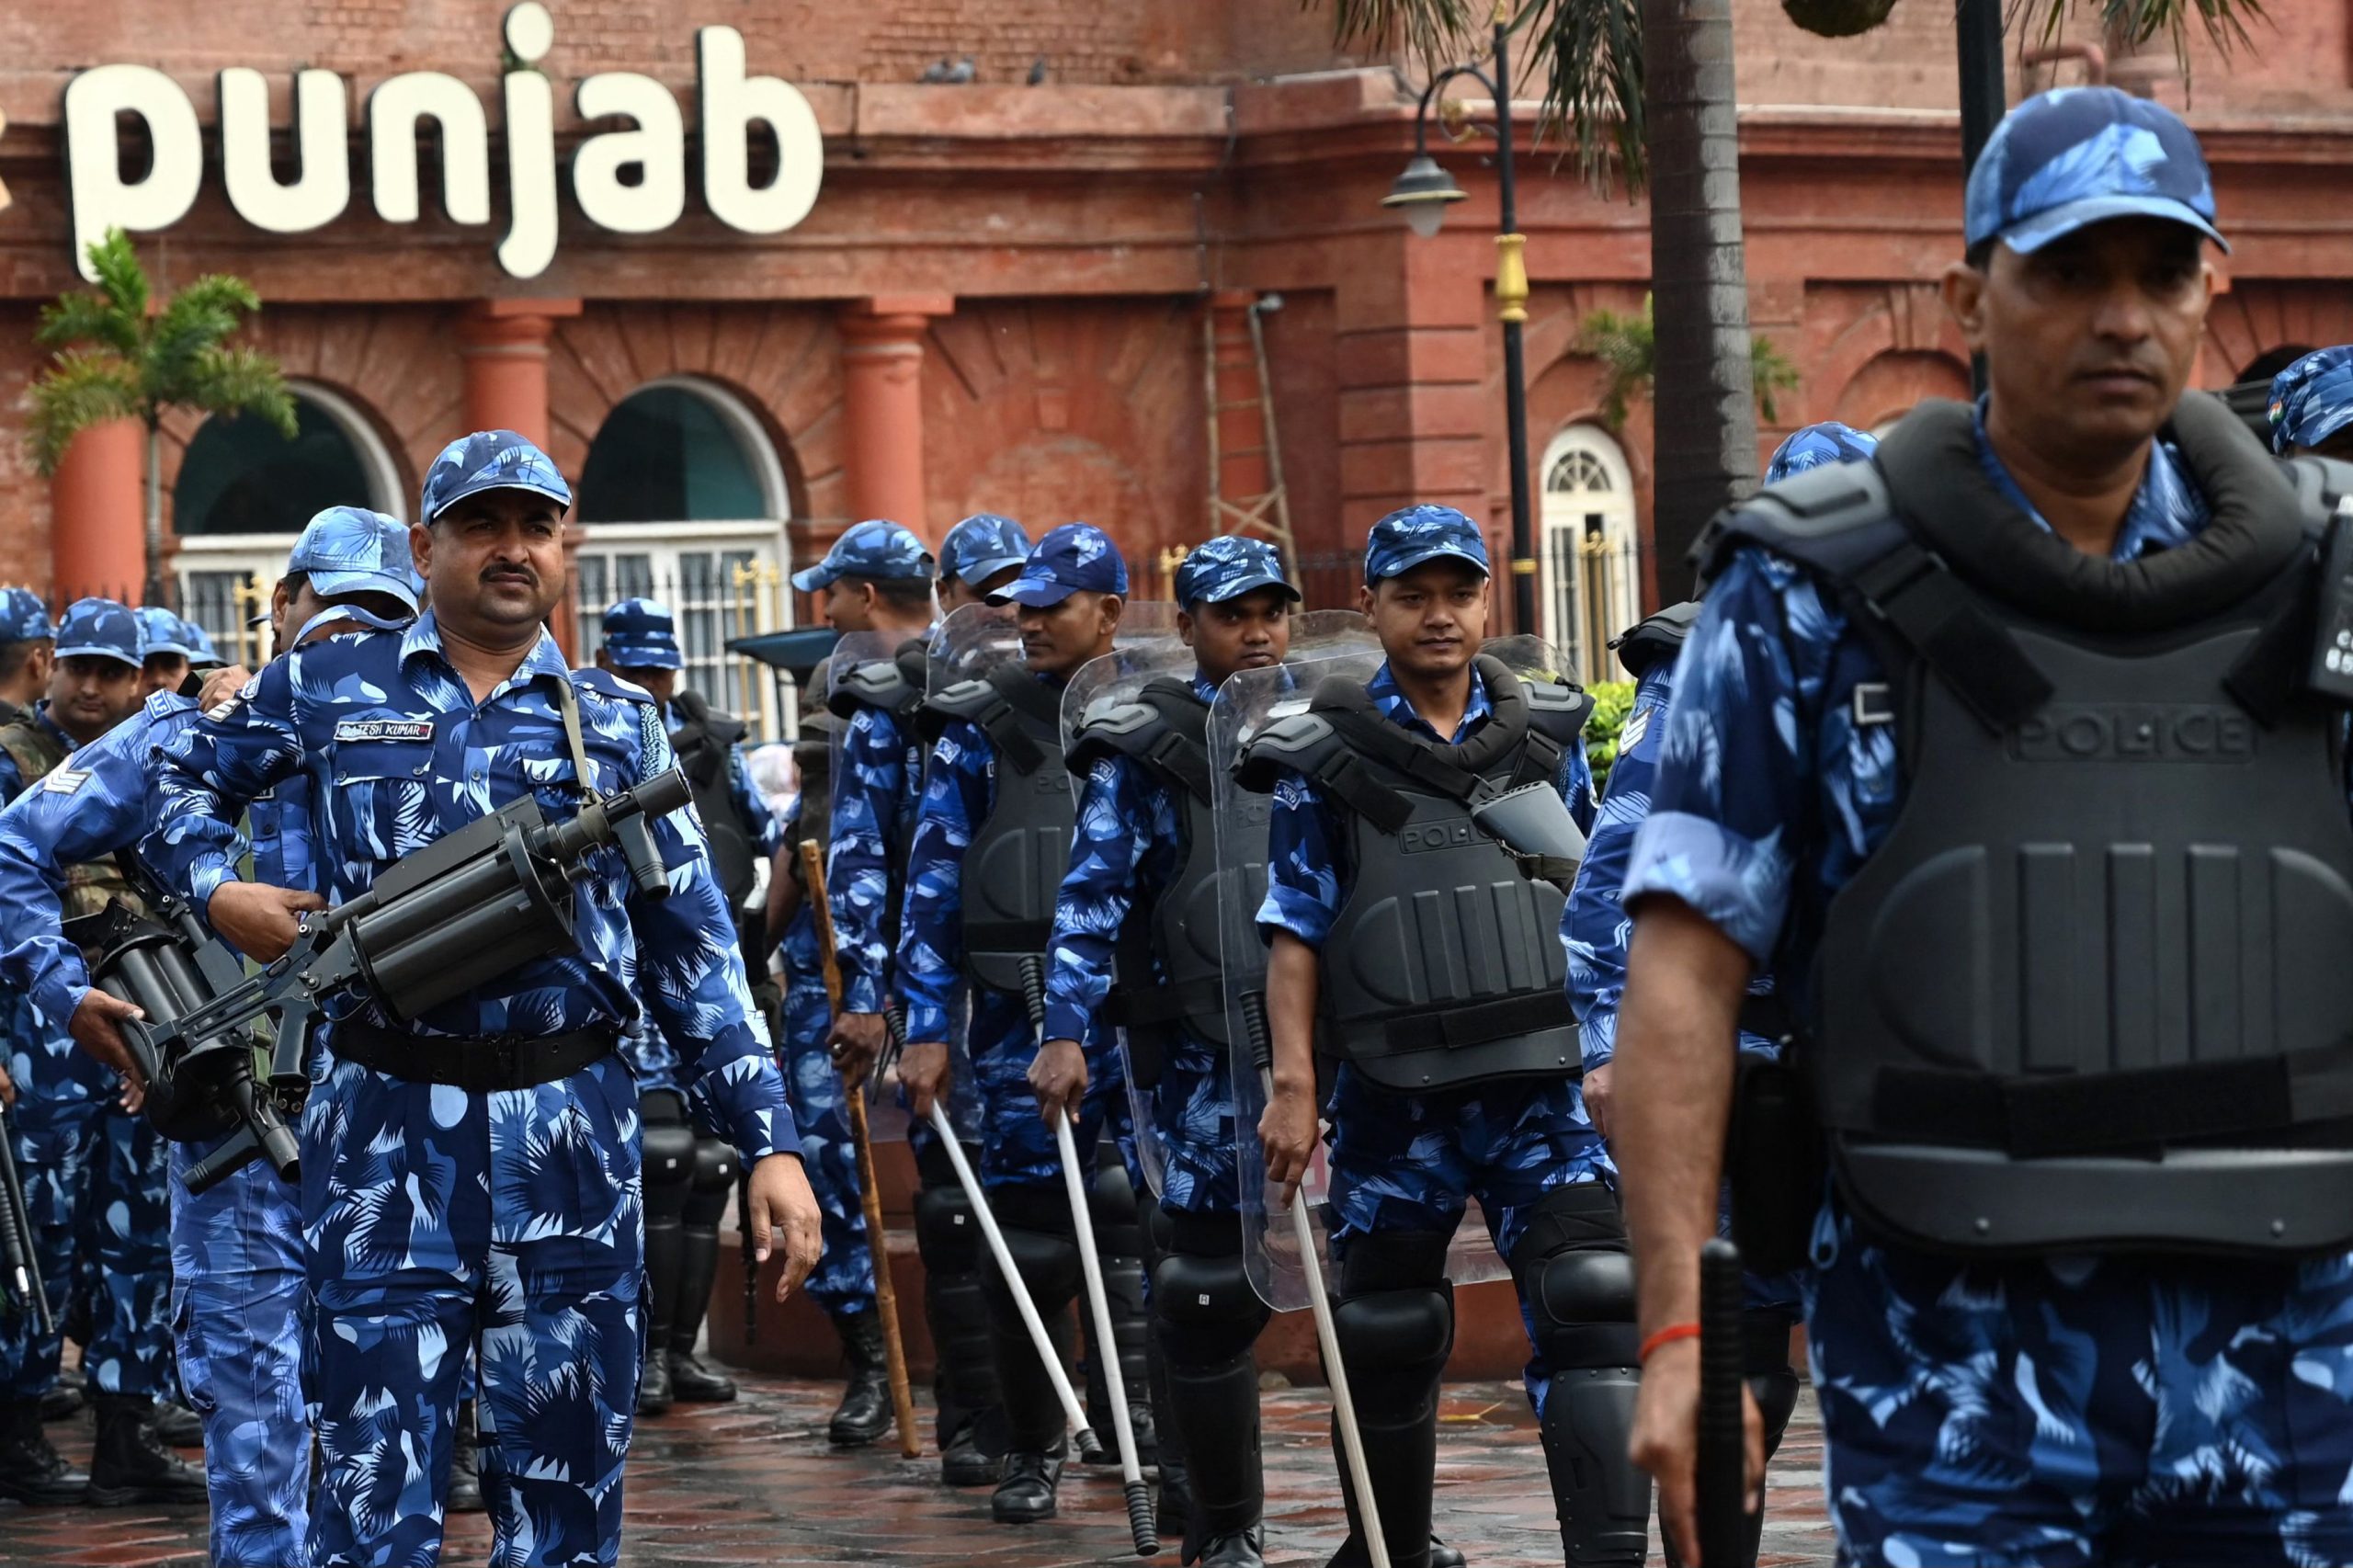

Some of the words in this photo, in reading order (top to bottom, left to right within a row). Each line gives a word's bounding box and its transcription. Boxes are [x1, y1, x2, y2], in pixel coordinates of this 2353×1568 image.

[65, 1, 824, 284] punjab
[386, 723, 420, 736] KUMAR
[2016, 713, 2251, 758] POLICE
[1402, 822, 1491, 852] POLI
